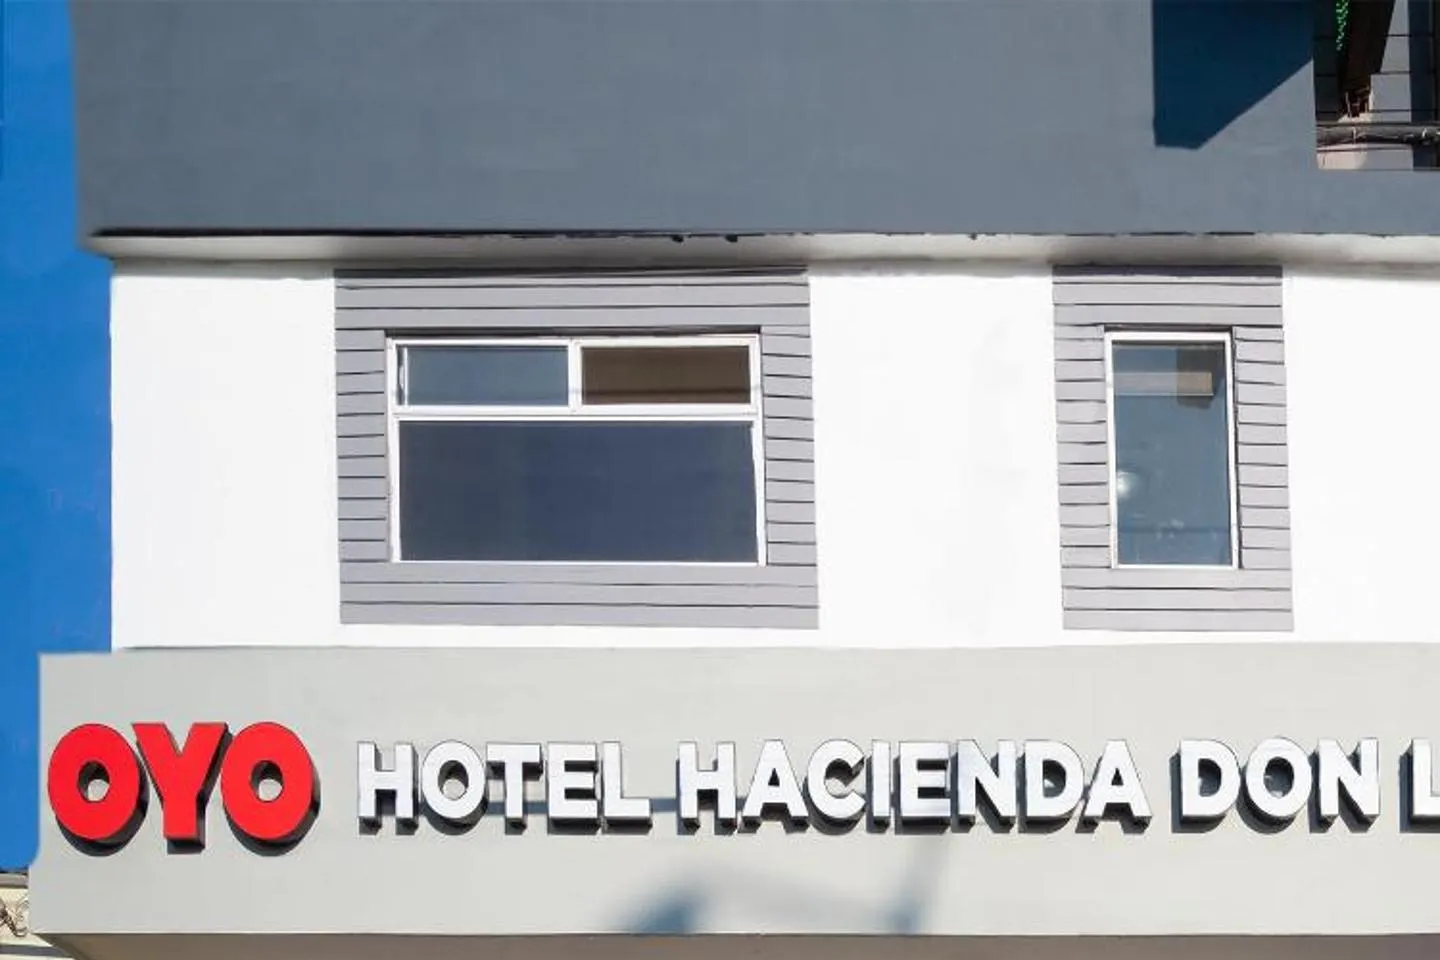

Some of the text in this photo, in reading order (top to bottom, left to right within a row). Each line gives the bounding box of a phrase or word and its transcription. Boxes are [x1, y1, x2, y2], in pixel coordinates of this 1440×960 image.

[47, 721, 316, 848] OYO
[356, 740, 650, 830] HOTEL
[678, 738, 1153, 829] HACIENDA
[1174, 736, 1381, 828] DON
